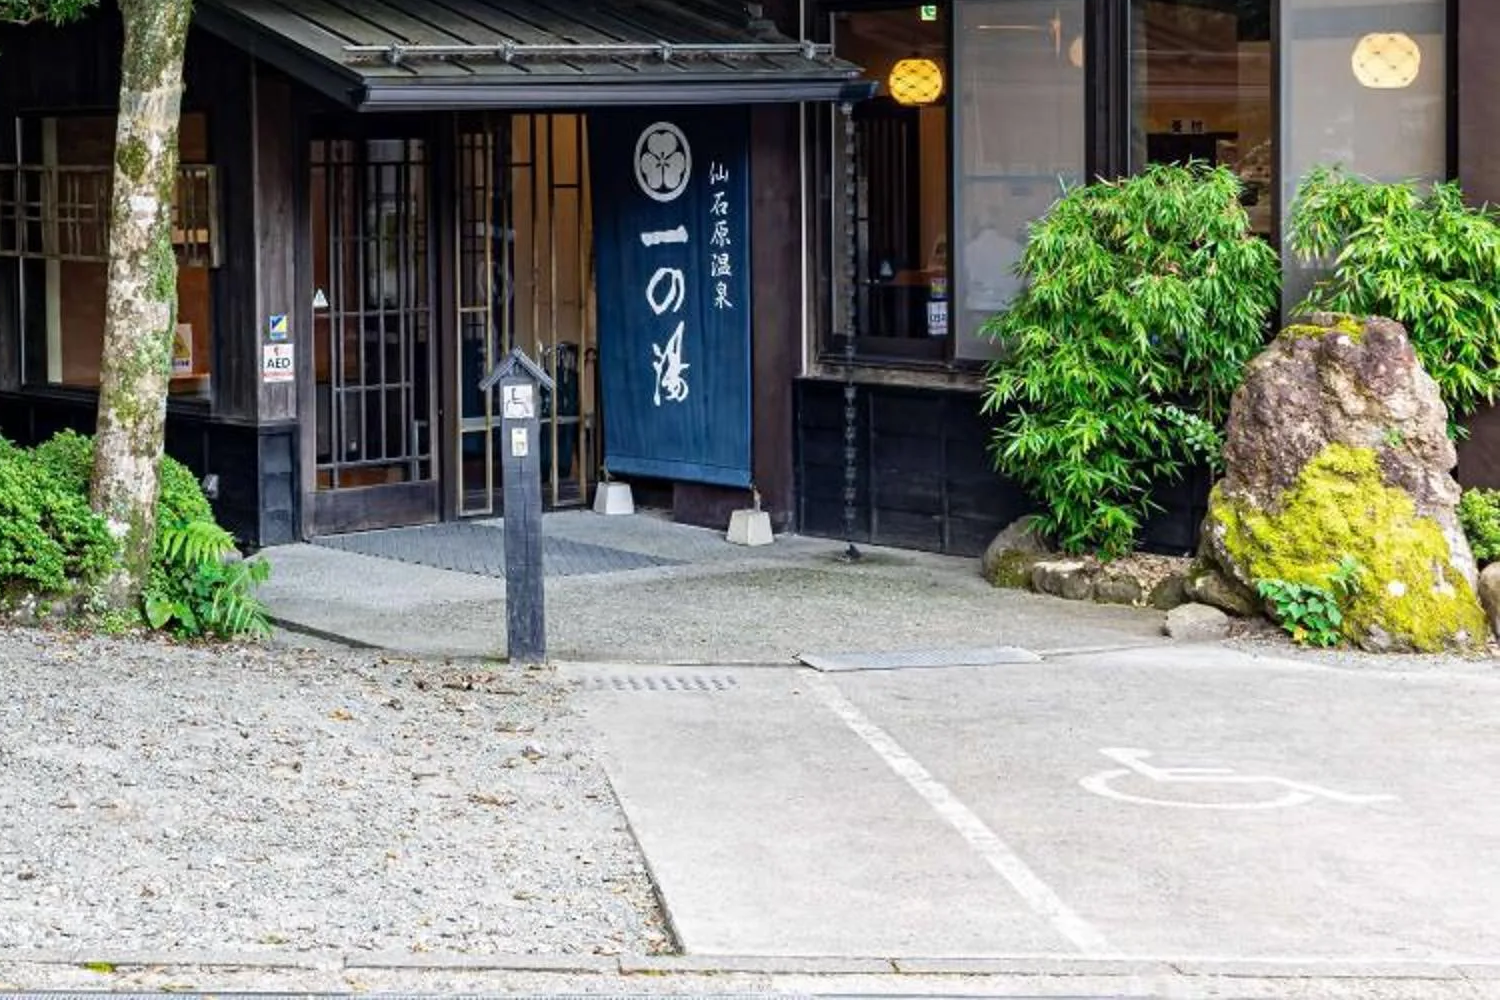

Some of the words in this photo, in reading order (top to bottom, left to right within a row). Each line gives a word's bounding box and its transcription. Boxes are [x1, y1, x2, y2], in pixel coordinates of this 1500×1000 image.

[708, 161, 734, 310] 仙石原温泉
[266, 357, 291, 369] AED
[640, 223, 691, 407] 一の湯
